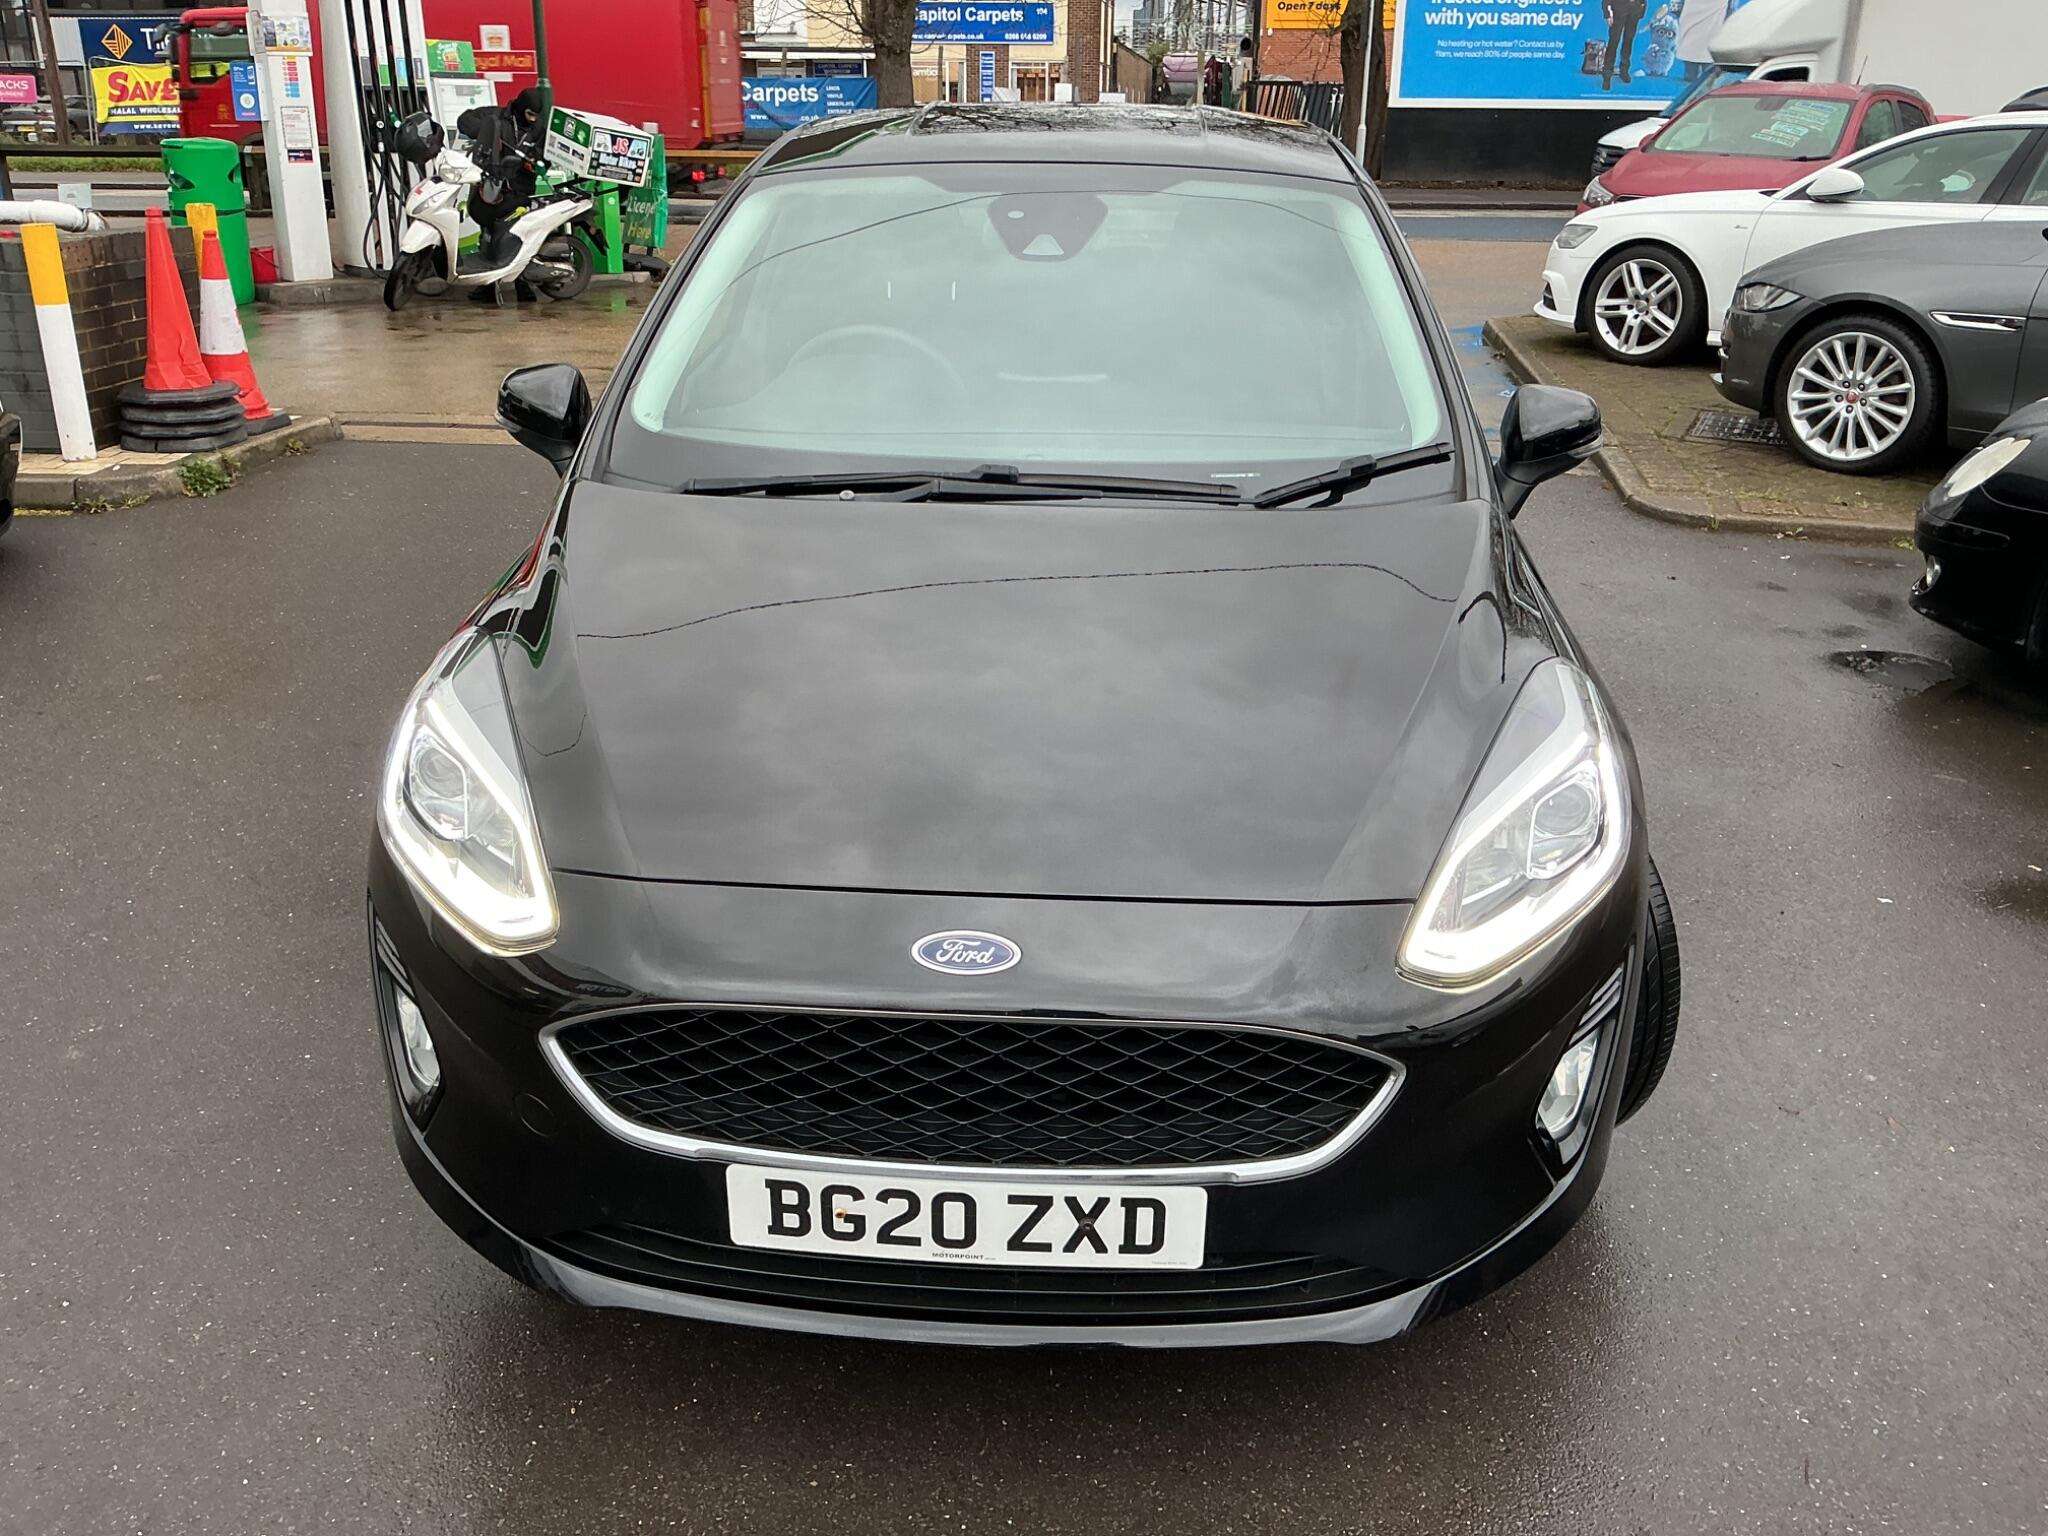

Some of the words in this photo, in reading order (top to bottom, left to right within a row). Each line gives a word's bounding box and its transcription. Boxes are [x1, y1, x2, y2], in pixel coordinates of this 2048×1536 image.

[915, 7, 961, 24] apitol
[965, 7, 1024, 24] Carpets
[1277, 2, 1306, 11] Open
[1425, 7, 1463, 25] with
[1466, 11, 1498, 29] you
[1500, 12, 1548, 26] same
[1550, 9, 1584, 30] day
[936, 939, 995, 963] Ford
[765, 1179, 976, 1249] BG20
[1007, 1195, 1166, 1255] ZXD
[931, 1252, 984, 1260] MOTORPOINT
